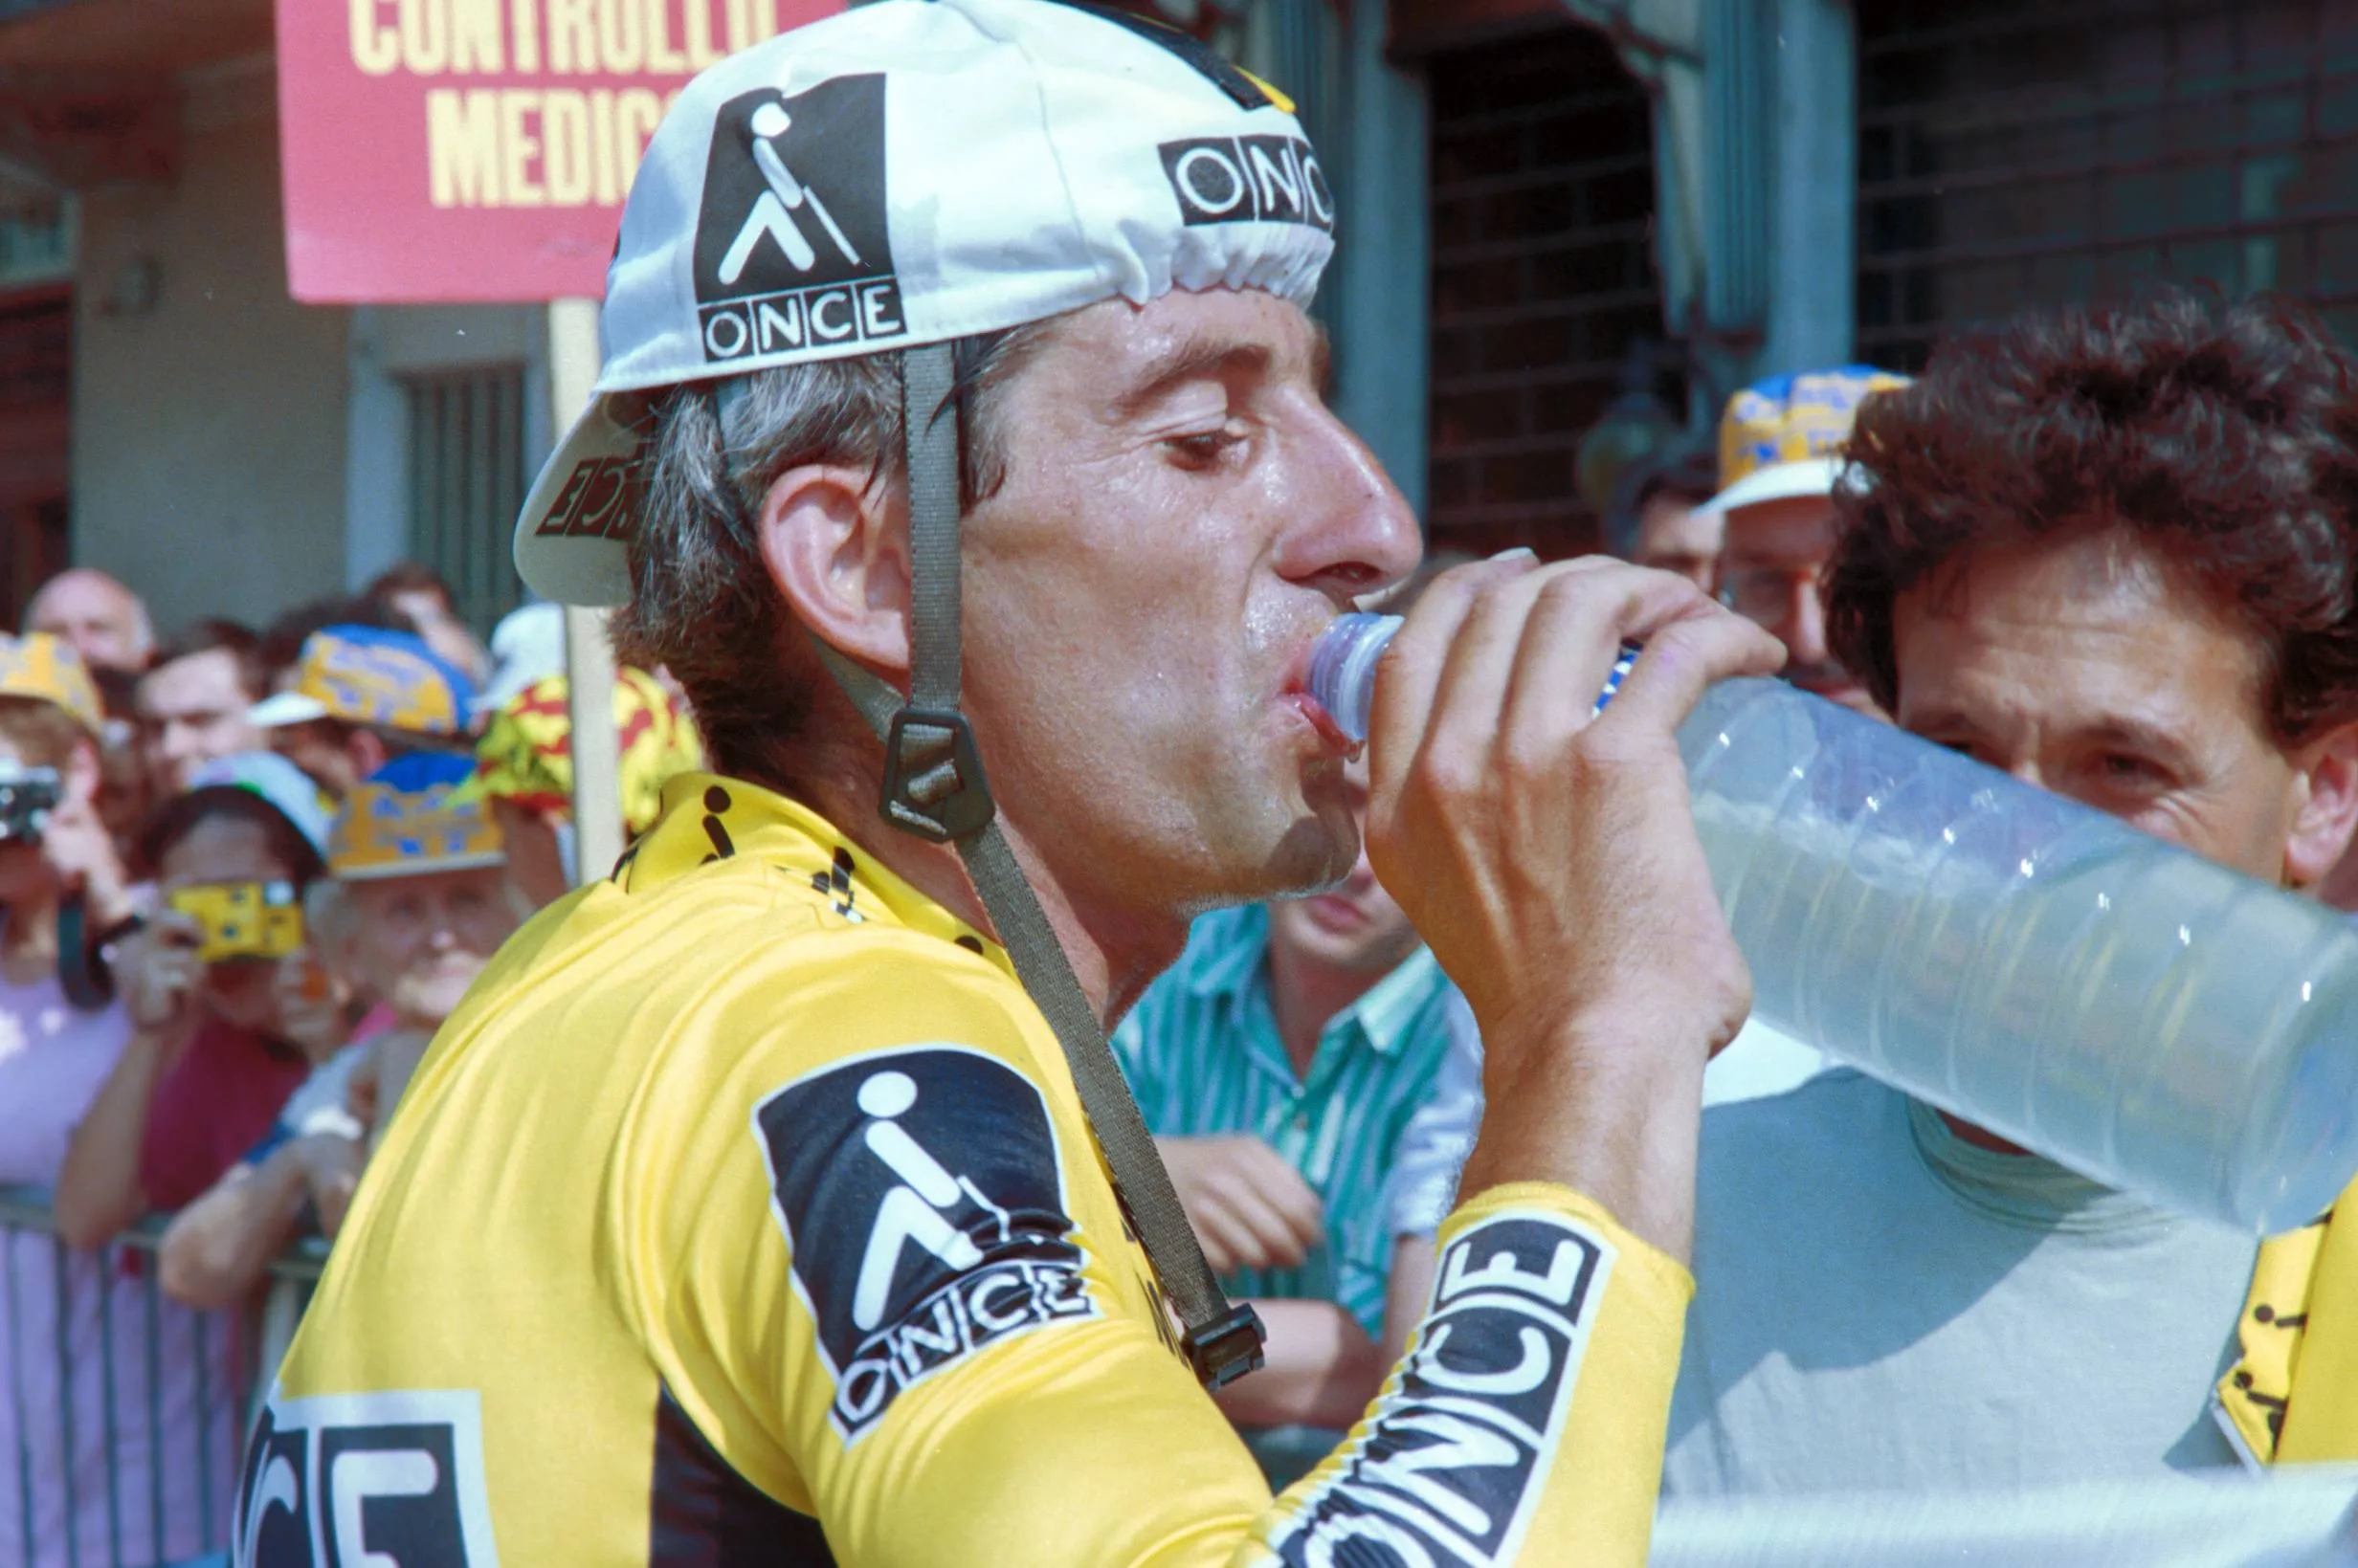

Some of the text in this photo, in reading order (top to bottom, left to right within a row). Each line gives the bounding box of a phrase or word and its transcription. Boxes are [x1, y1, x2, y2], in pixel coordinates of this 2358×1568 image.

[427, 88, 679, 209] MEDIC
[706, 285, 901, 358] ONCE
[836, 1270, 1087, 1423] ONCE
